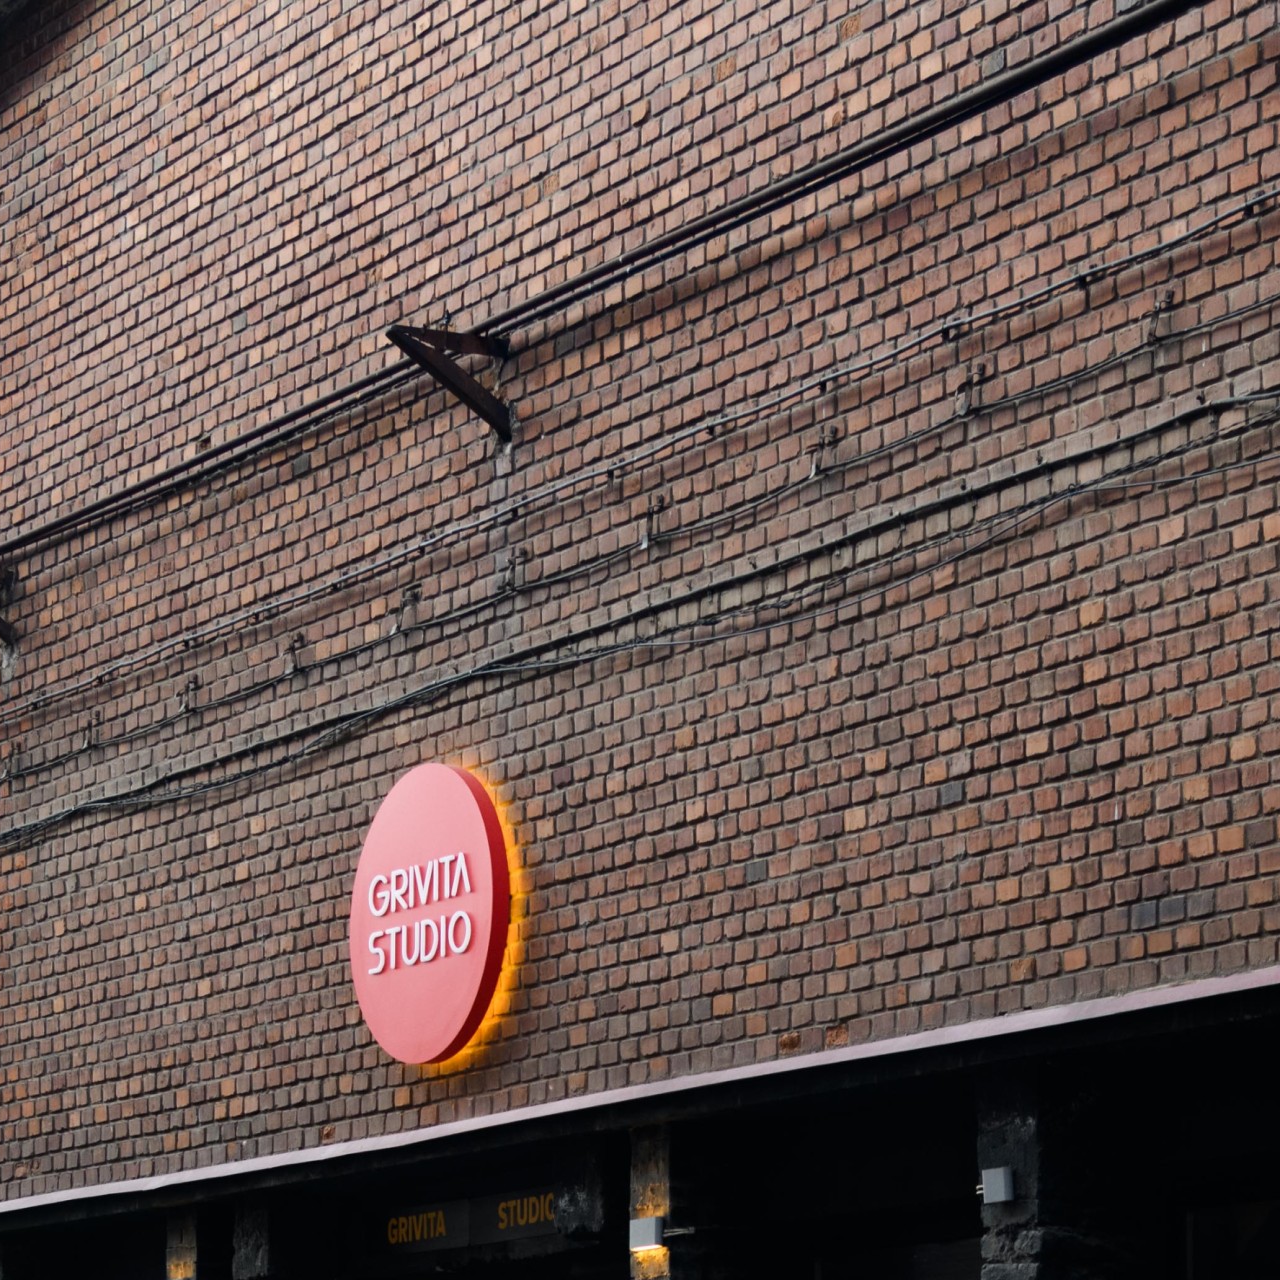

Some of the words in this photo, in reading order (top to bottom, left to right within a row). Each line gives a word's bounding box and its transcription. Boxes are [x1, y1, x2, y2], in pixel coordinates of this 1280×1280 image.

[368, 851, 472, 917] GRIVITA
[368, 910, 472, 975] STUDIO
[387, 1209, 447, 1246] GRIVITA
